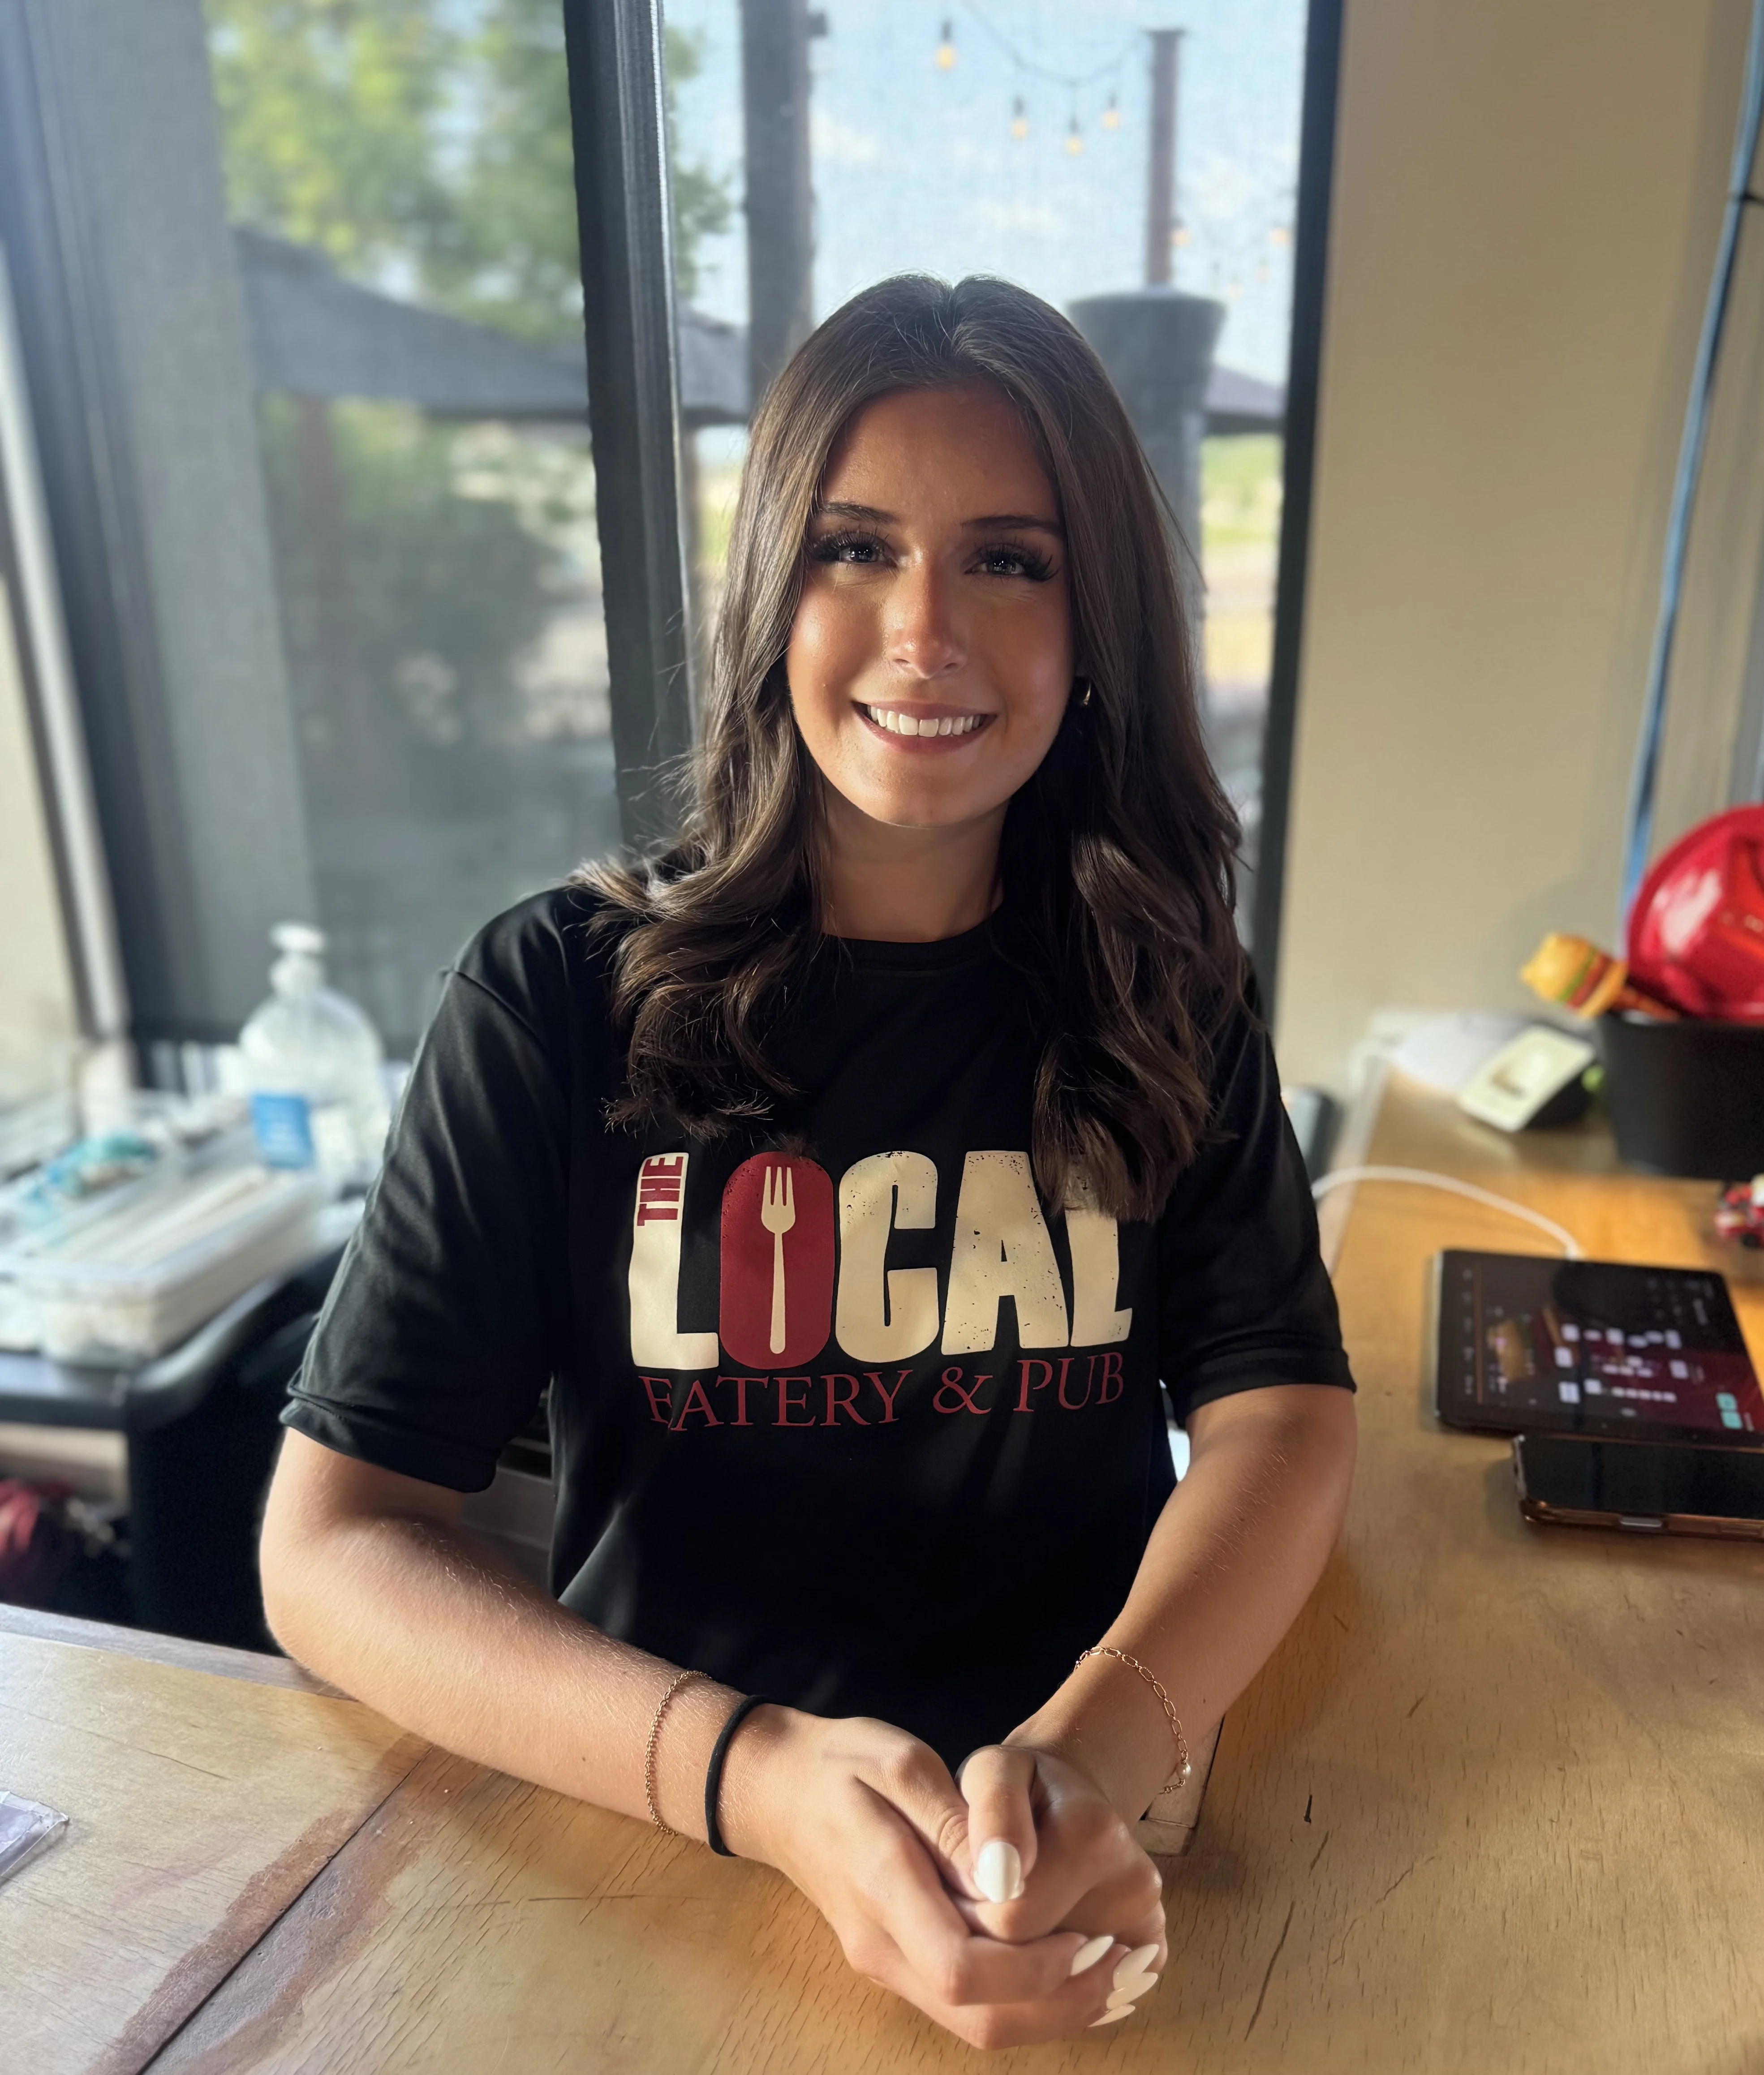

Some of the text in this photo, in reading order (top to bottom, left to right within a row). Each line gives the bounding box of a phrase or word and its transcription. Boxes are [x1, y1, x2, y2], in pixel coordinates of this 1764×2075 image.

[637, 1156, 684, 1227] THE
[628, 1150, 1132, 1370] LOCAL
[638, 1352, 1124, 1432] EATERY & PUB
